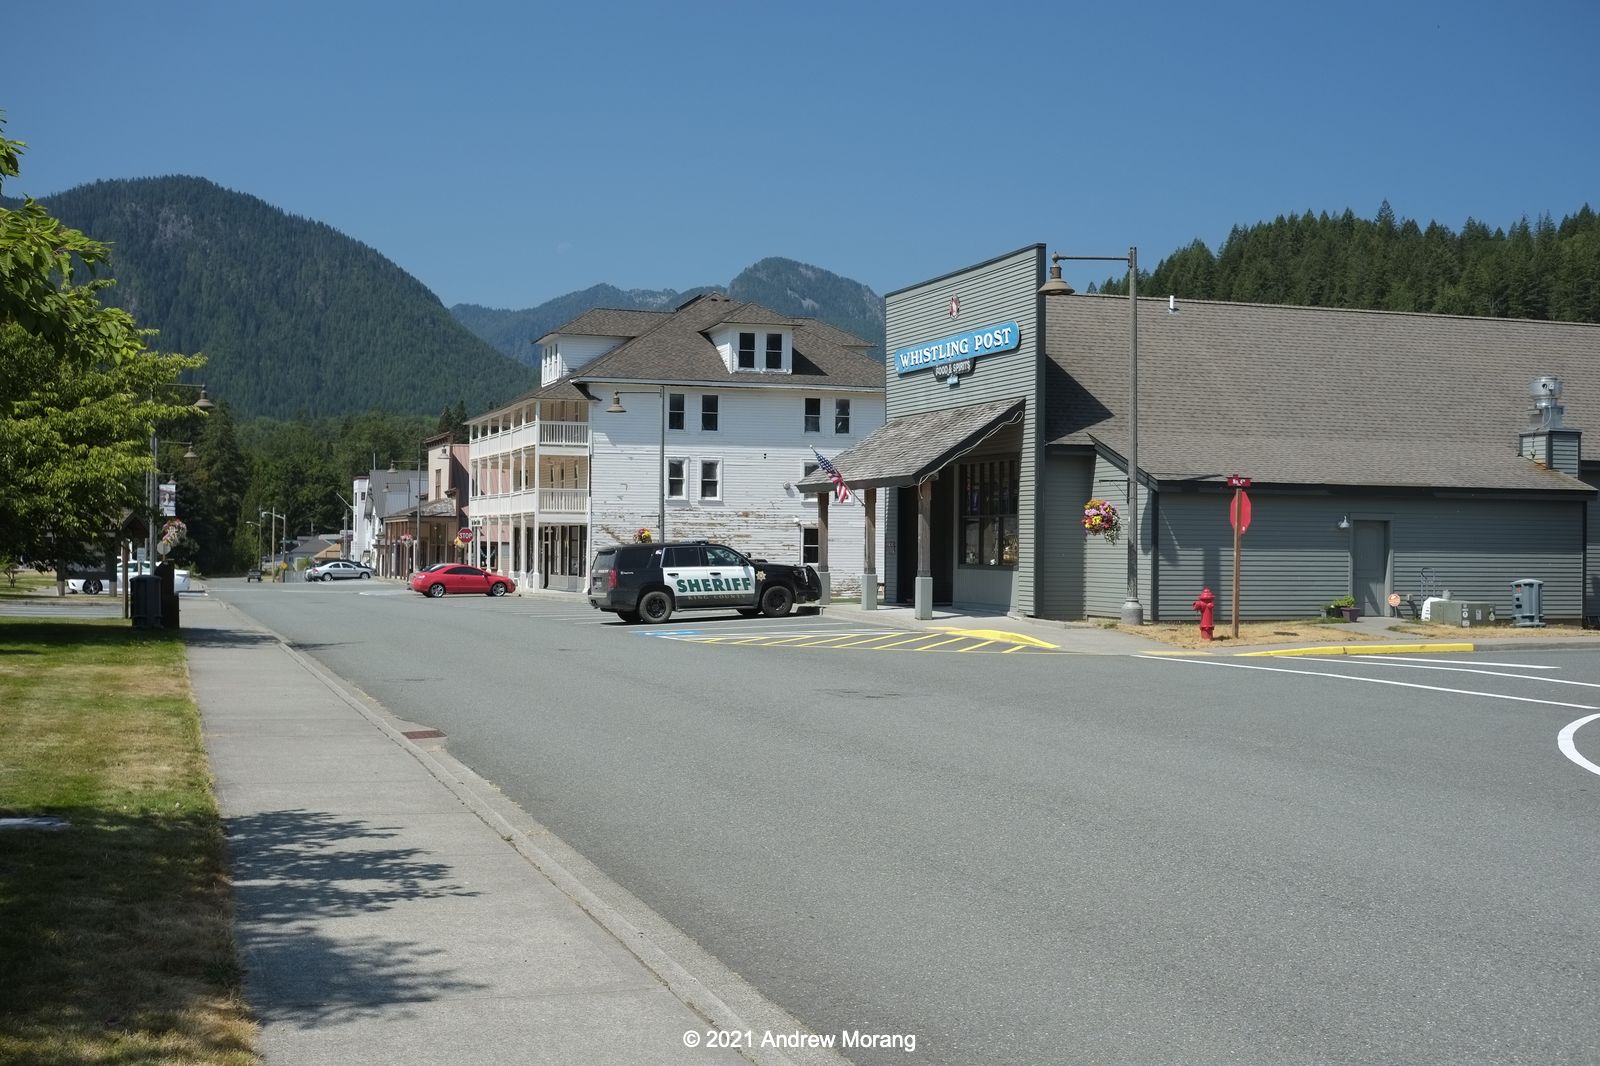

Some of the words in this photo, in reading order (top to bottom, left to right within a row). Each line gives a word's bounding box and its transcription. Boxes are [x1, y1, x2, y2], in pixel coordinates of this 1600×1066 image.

[900, 338, 968, 368] WHISTLING
[974, 327, 1011, 350] POST
[676, 578, 751, 593] SHERIFF
